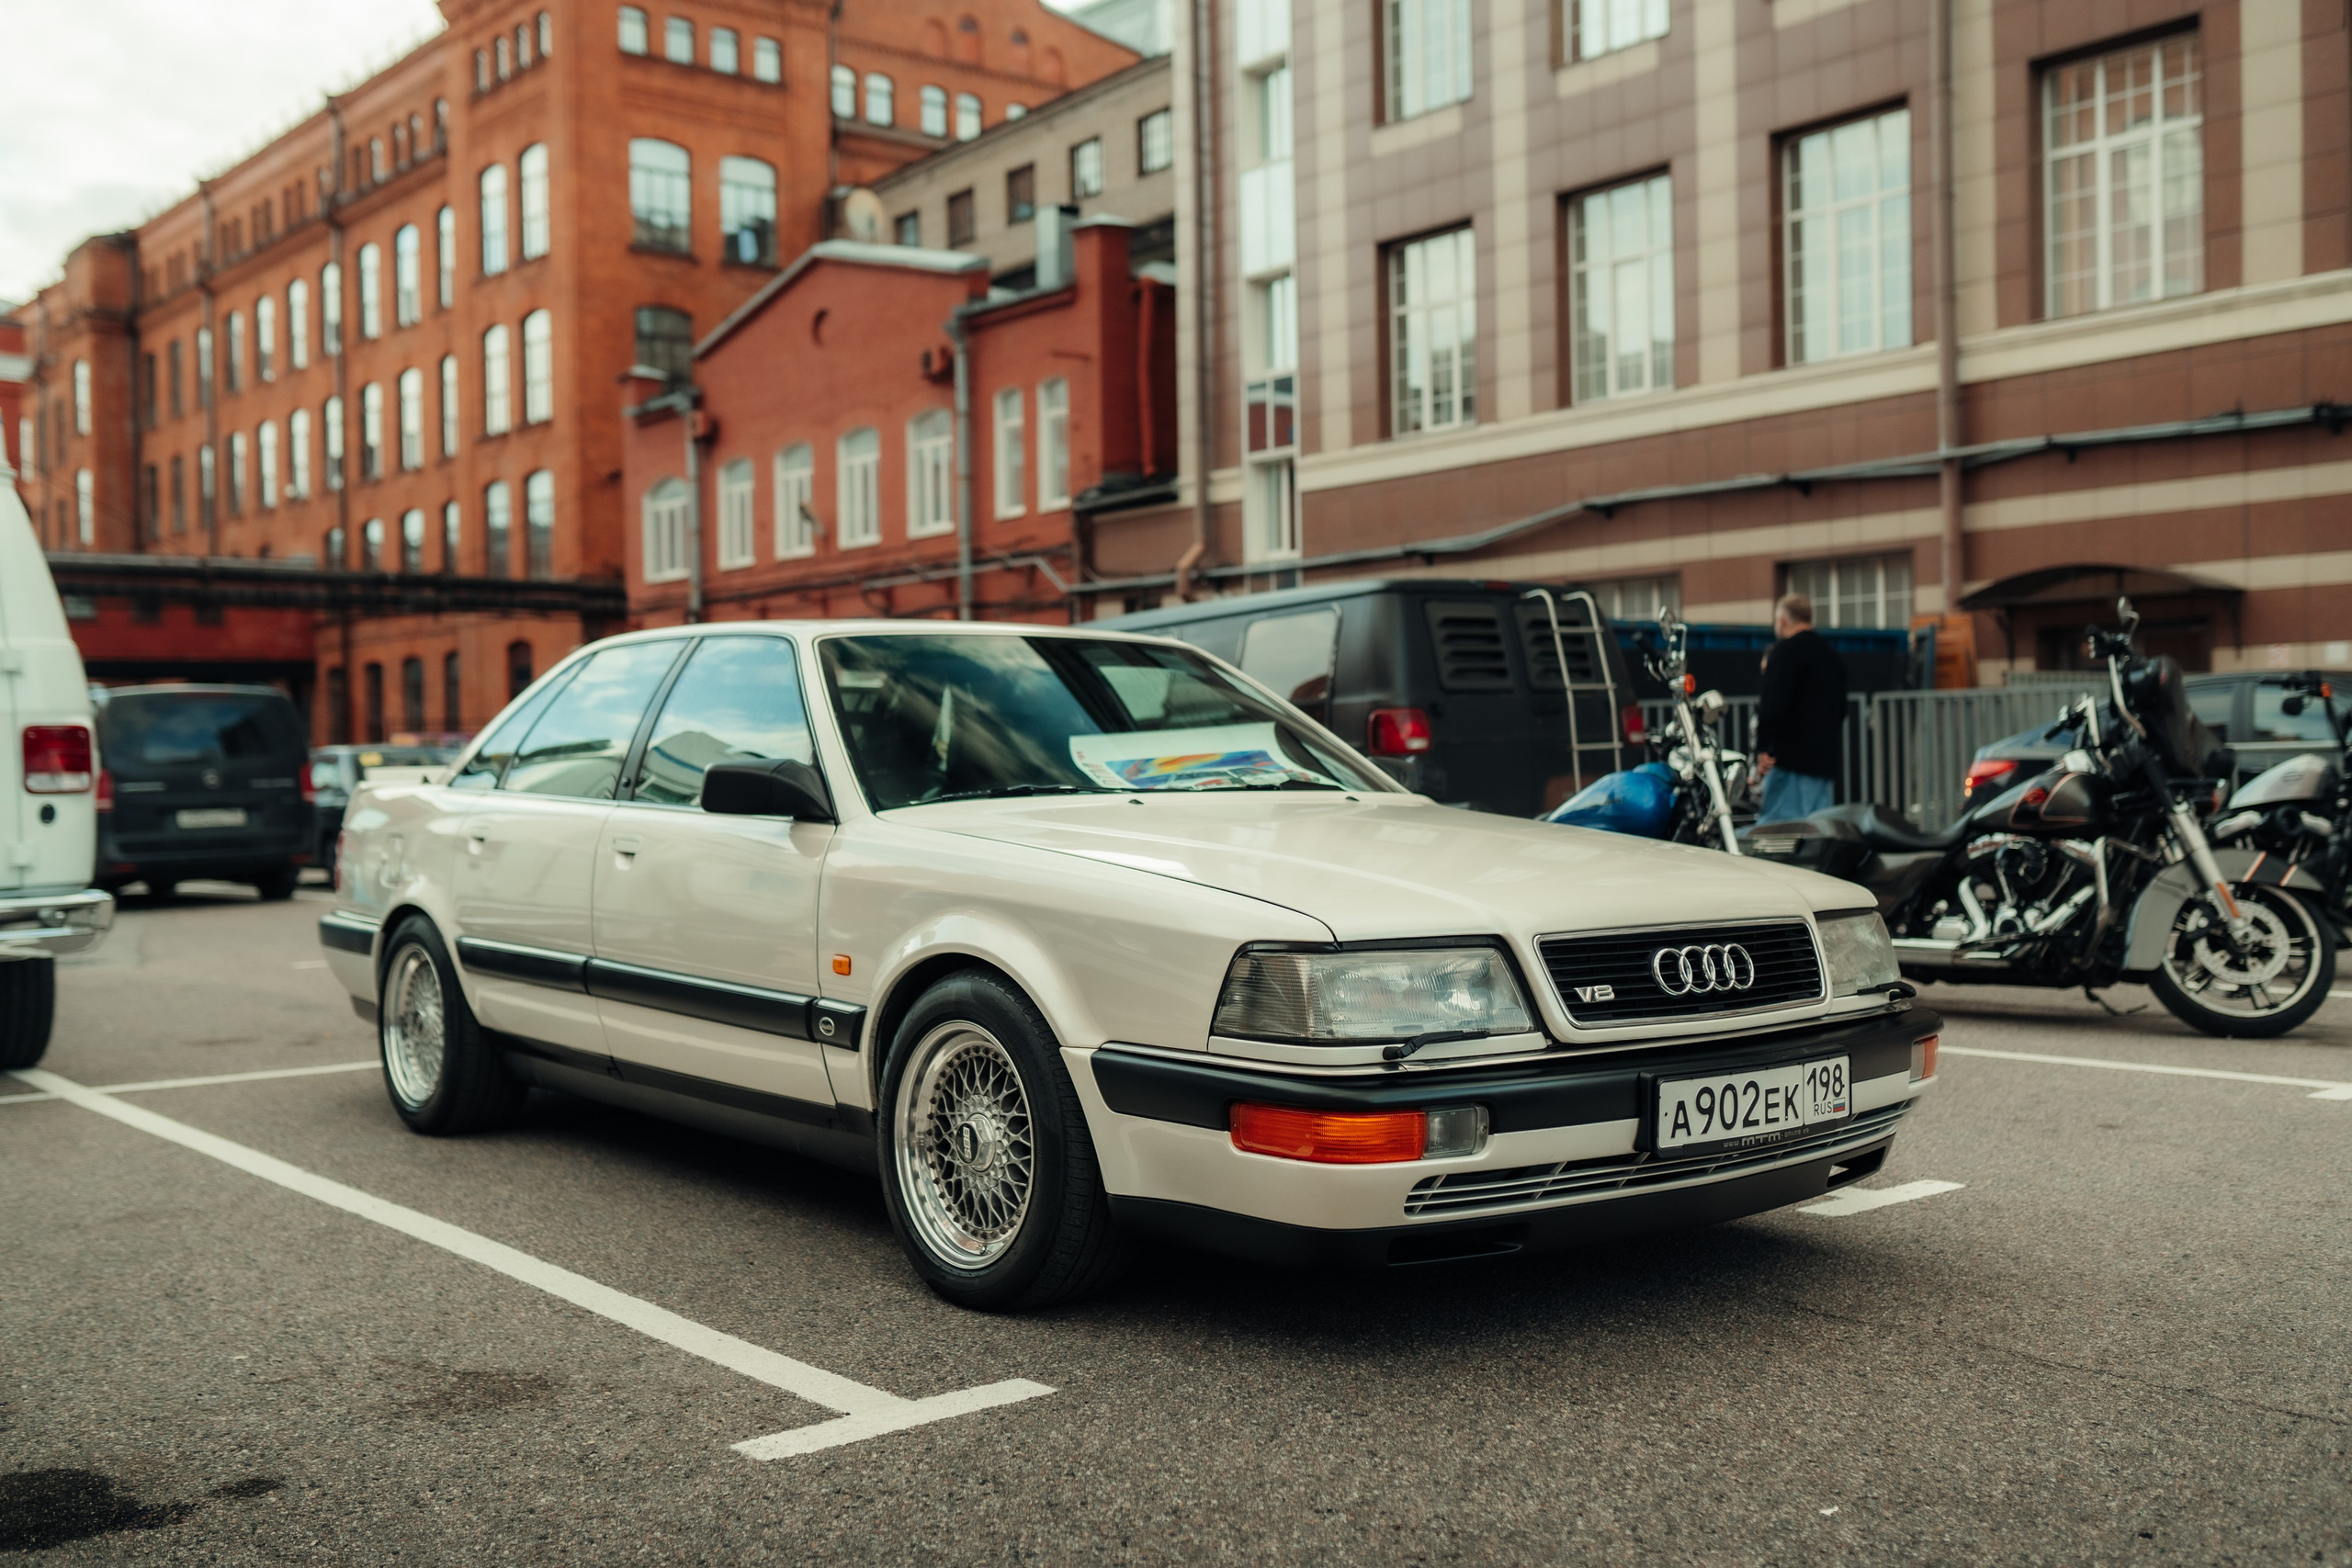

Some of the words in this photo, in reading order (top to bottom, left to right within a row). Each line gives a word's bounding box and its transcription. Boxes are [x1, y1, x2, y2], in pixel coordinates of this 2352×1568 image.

[1573, 984, 1615, 1003] V8
[1806, 1063, 1844, 1103] 198
[1814, 1101, 1833, 1117] RUS
[962, 1126, 972, 1159] BBS
